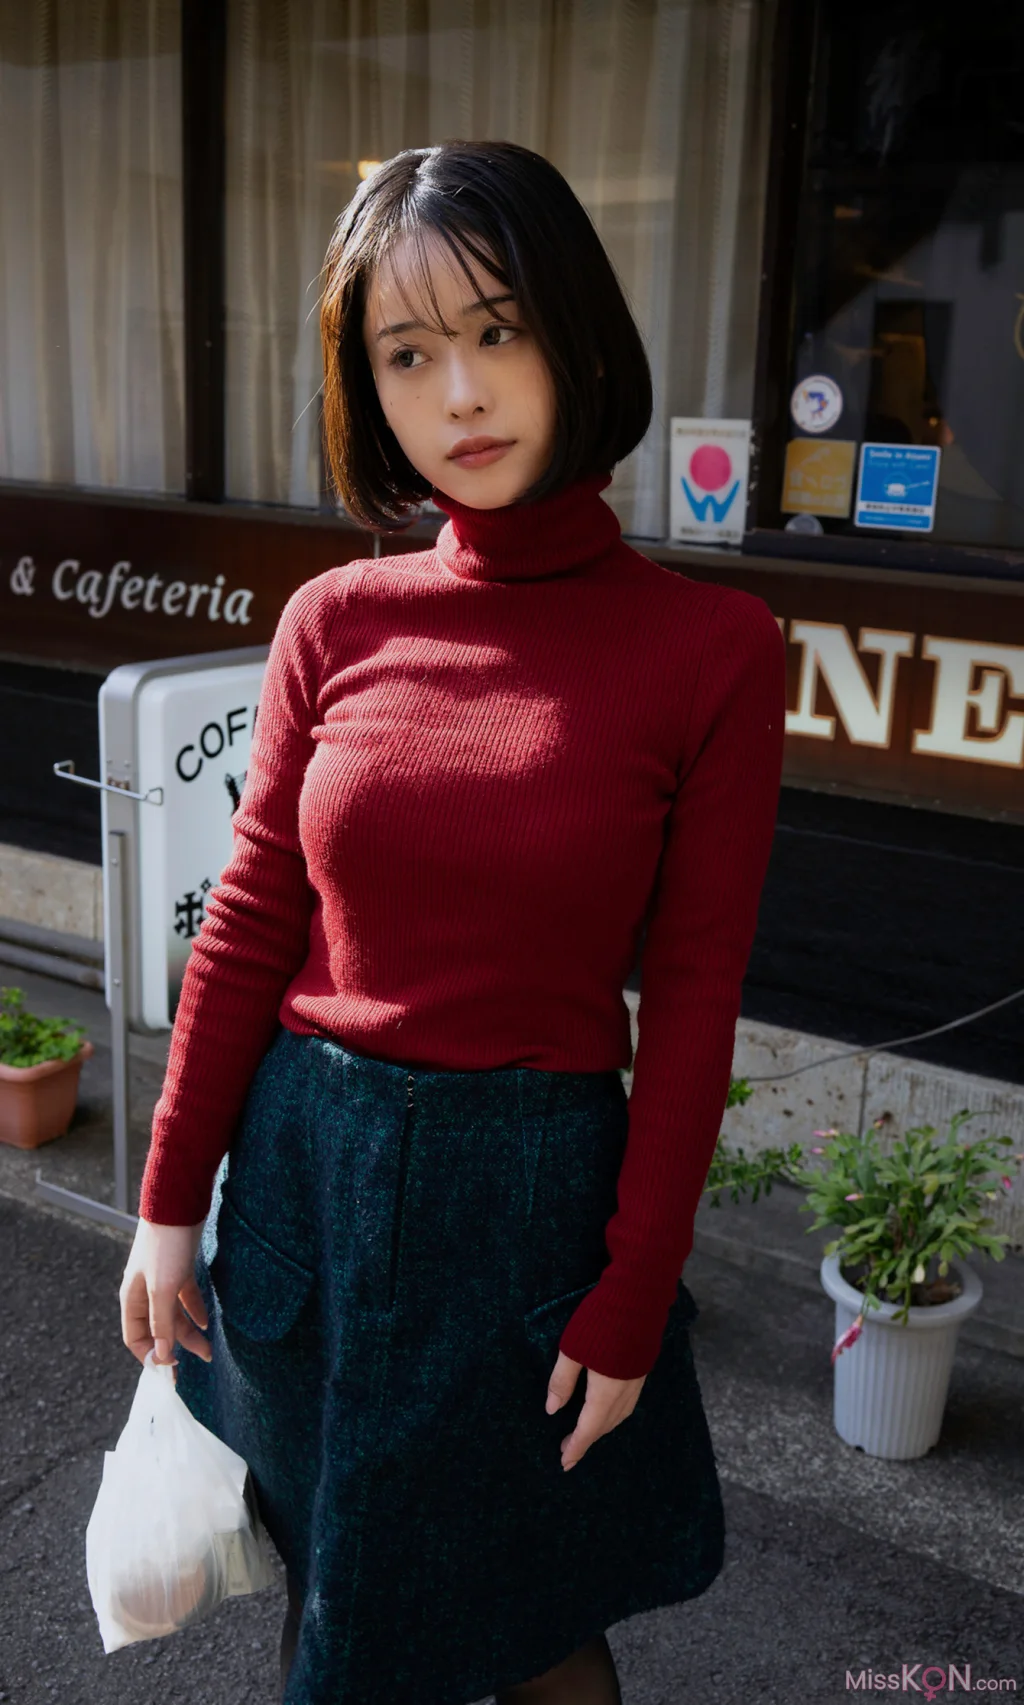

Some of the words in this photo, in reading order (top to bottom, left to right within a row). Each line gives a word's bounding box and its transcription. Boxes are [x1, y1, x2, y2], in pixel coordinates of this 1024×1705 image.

[10, 555, 35, 596] &
[52, 559, 254, 626] Cafeteria
[774, 616, 1024, 770] NE
[175, 706, 259, 782] COF
